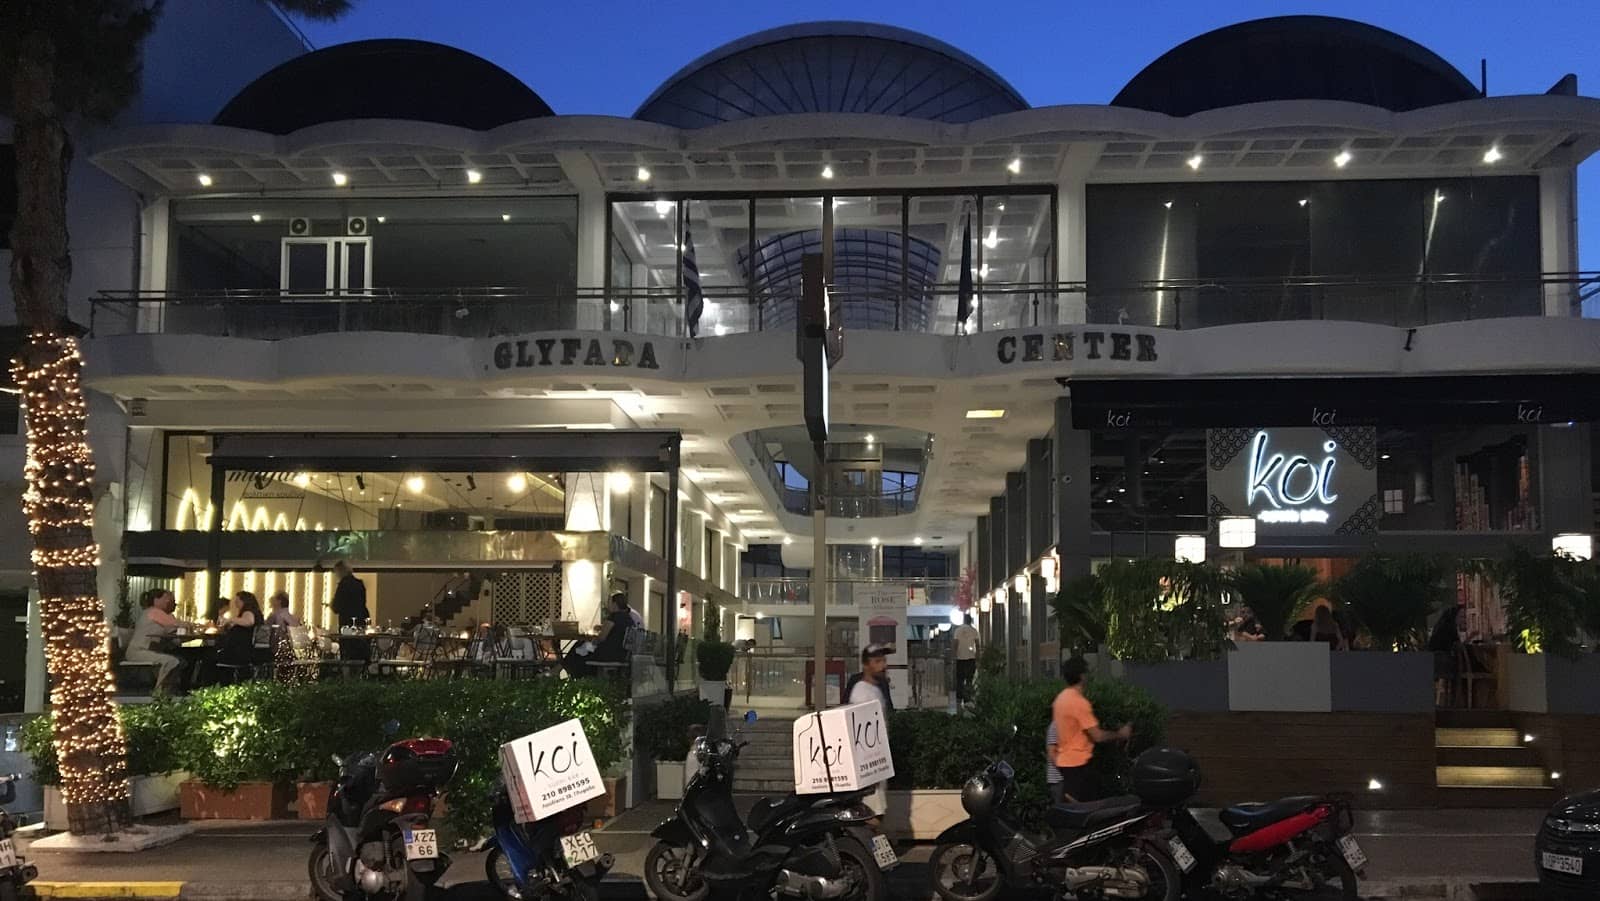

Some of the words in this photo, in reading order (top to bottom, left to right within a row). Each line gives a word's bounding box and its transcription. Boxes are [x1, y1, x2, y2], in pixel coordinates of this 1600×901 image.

[494, 338, 660, 370] GLYFADA
[997, 332, 1158, 364] CENTER
[1107, 409, 1131, 427] koi
[1312, 407, 1337, 425] koi
[1246, 430, 1338, 508] koi
[852, 711, 881, 751] koi
[528, 732, 583, 782] koi
[541, 790, 556, 801] 210
[557, 777, 590, 795] 8981595
[418, 845, 433, 856] 66
